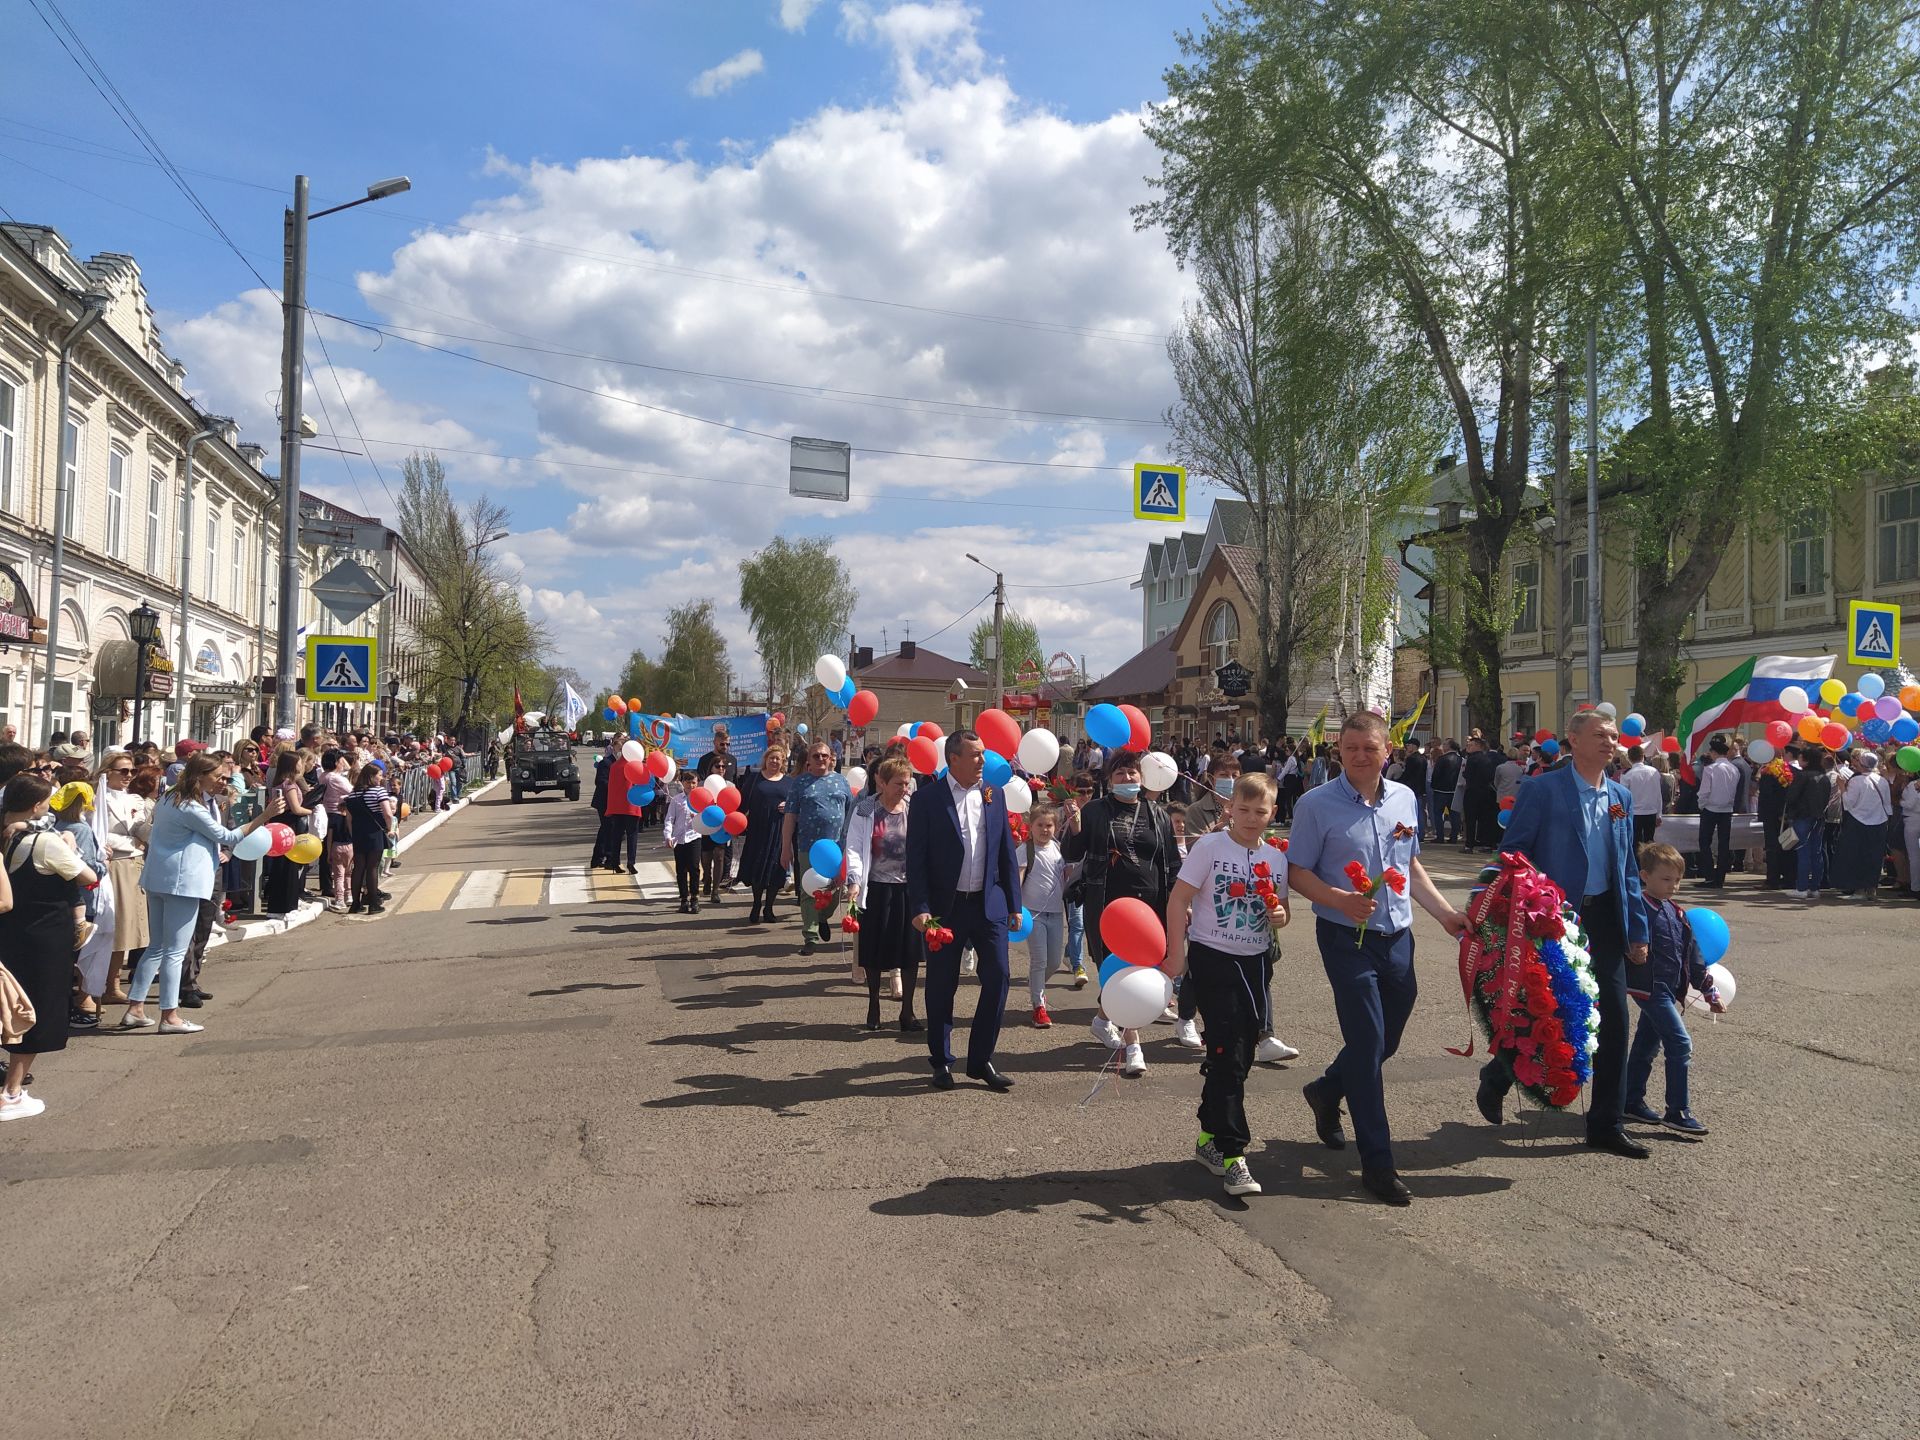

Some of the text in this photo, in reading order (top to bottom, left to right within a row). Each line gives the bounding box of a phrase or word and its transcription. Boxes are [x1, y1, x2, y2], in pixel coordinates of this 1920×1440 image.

[650, 719, 672, 750] 9
[1213, 860, 1247, 876] FEEL
[1210, 929, 1264, 945] IT HAPPENS
[1509, 945, 1522, 974] ФСС
